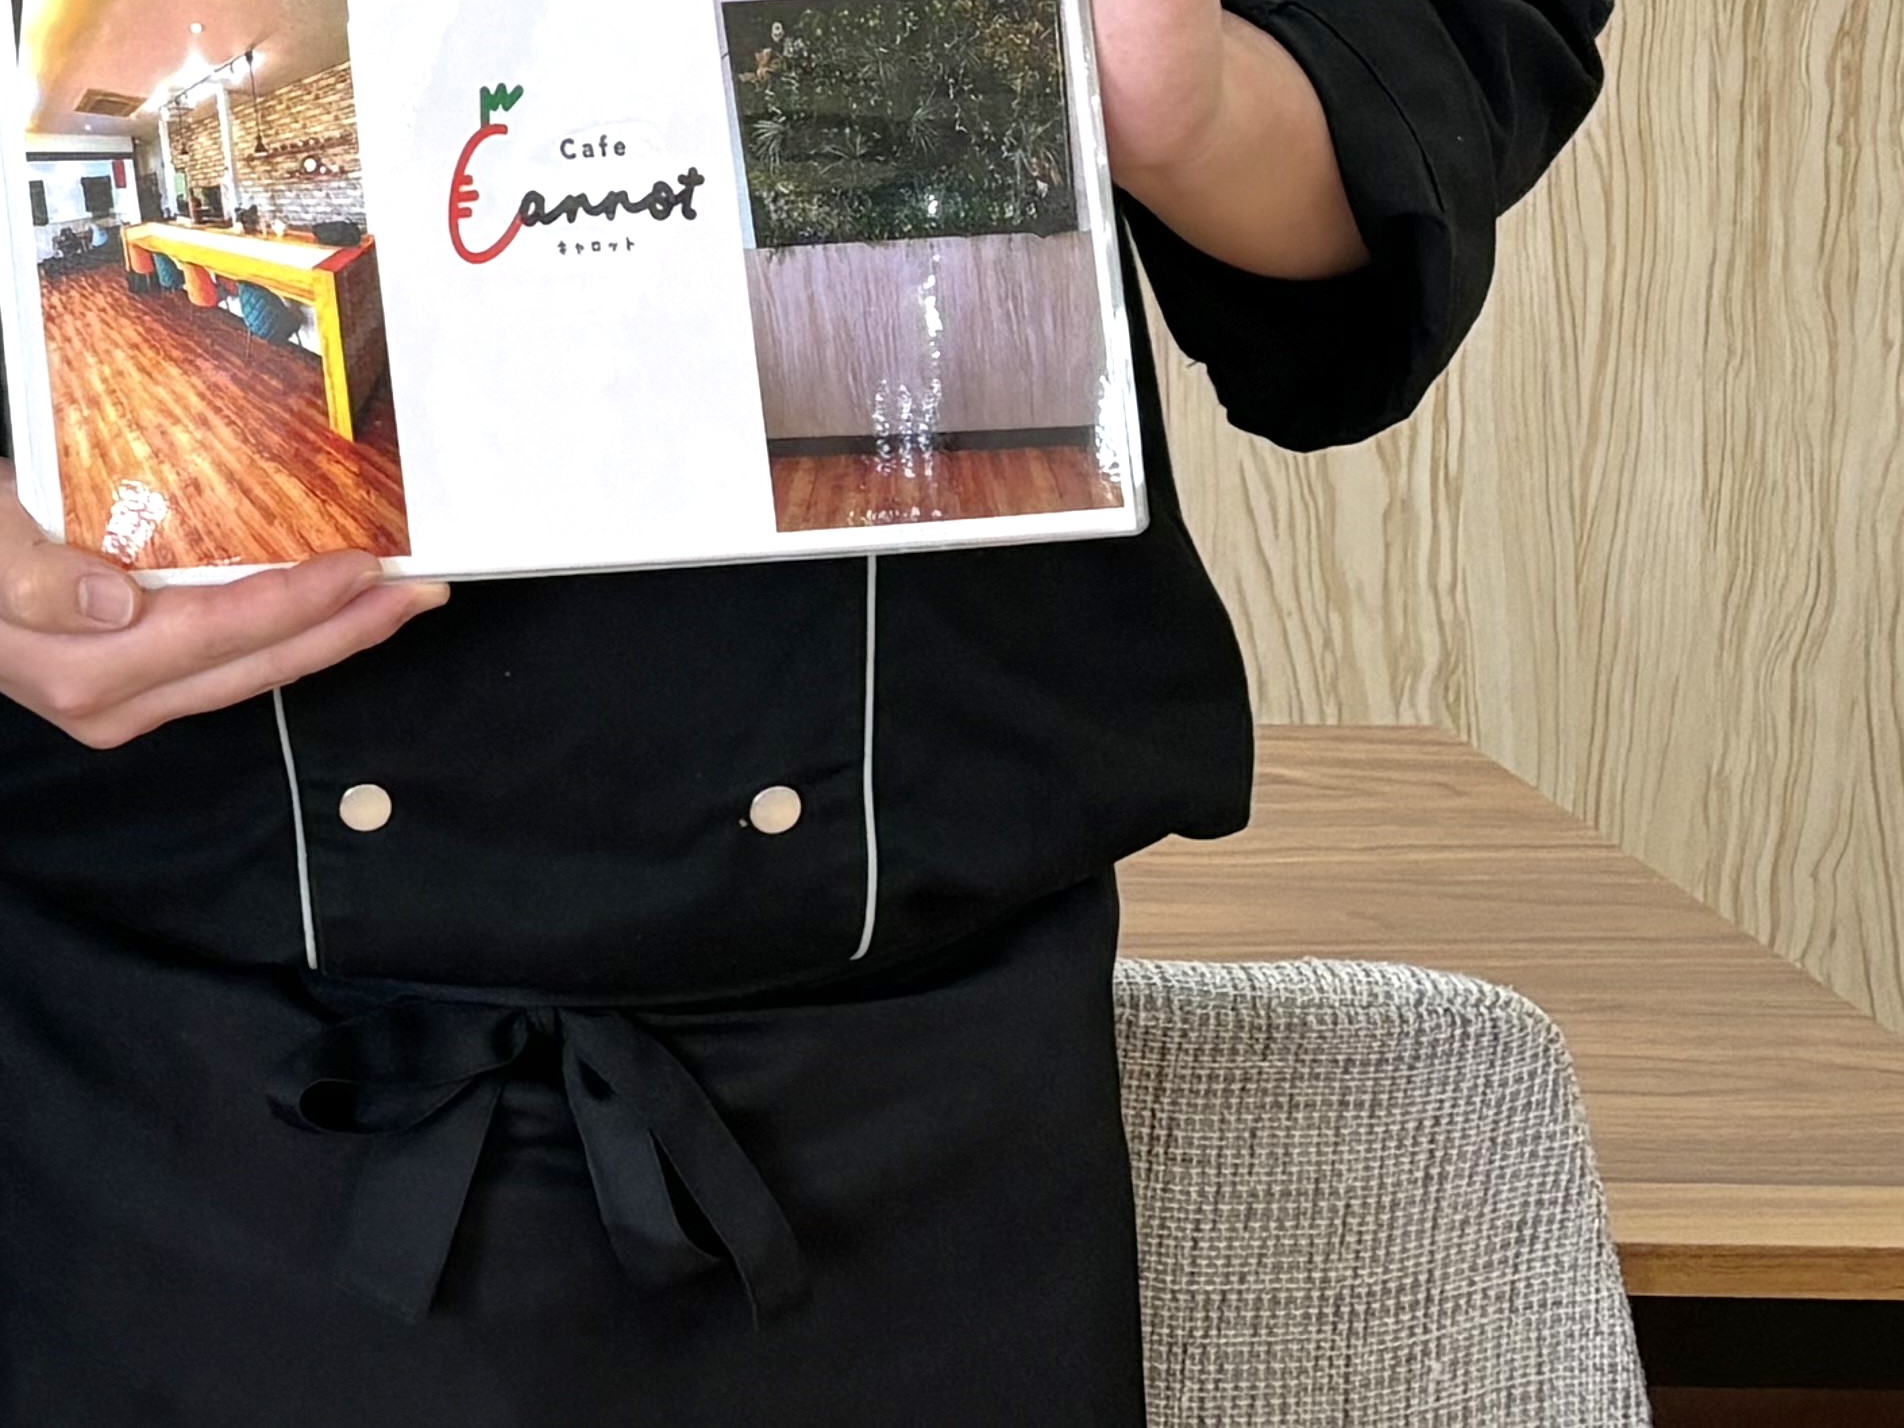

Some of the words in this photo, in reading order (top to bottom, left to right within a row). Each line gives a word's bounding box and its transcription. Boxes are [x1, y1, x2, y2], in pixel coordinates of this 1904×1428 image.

[559, 135, 626, 159] Cafe
[557, 237, 635, 255] キャロット
